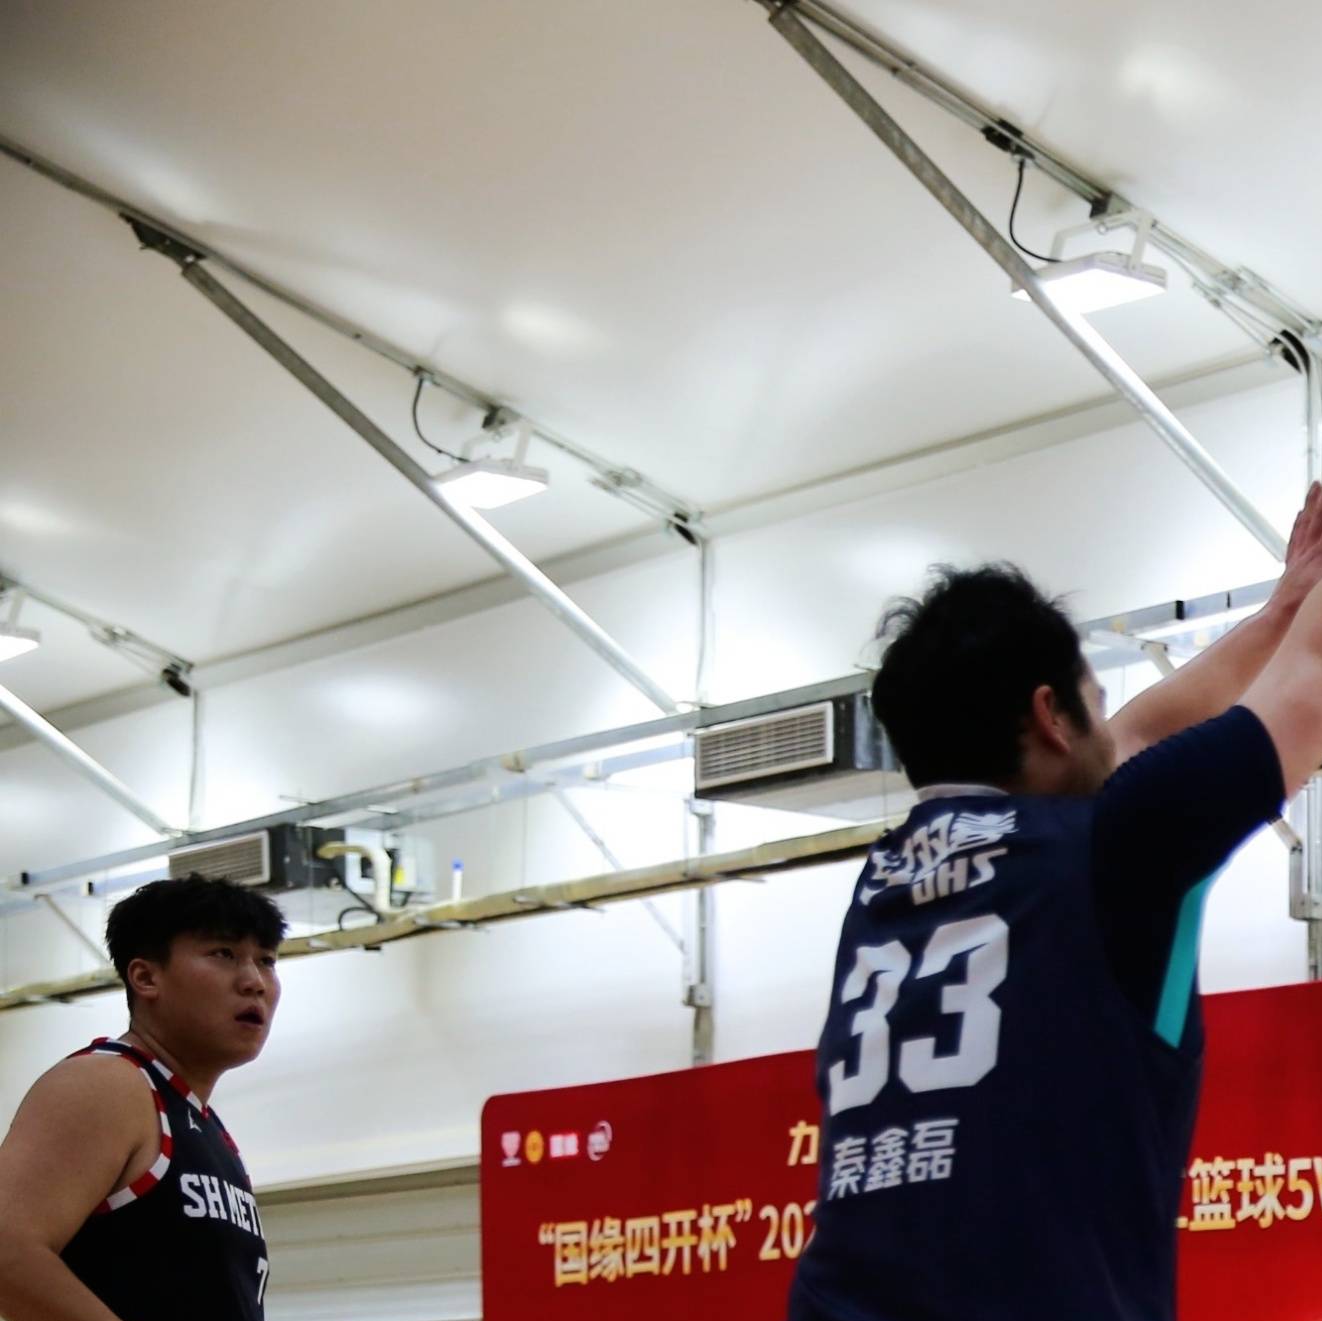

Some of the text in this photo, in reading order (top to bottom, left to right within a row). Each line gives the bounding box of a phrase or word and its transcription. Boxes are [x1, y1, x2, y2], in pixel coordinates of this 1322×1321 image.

[828, 913, 1009, 1117] 33
[180, 1173, 265, 1240] SH MET
